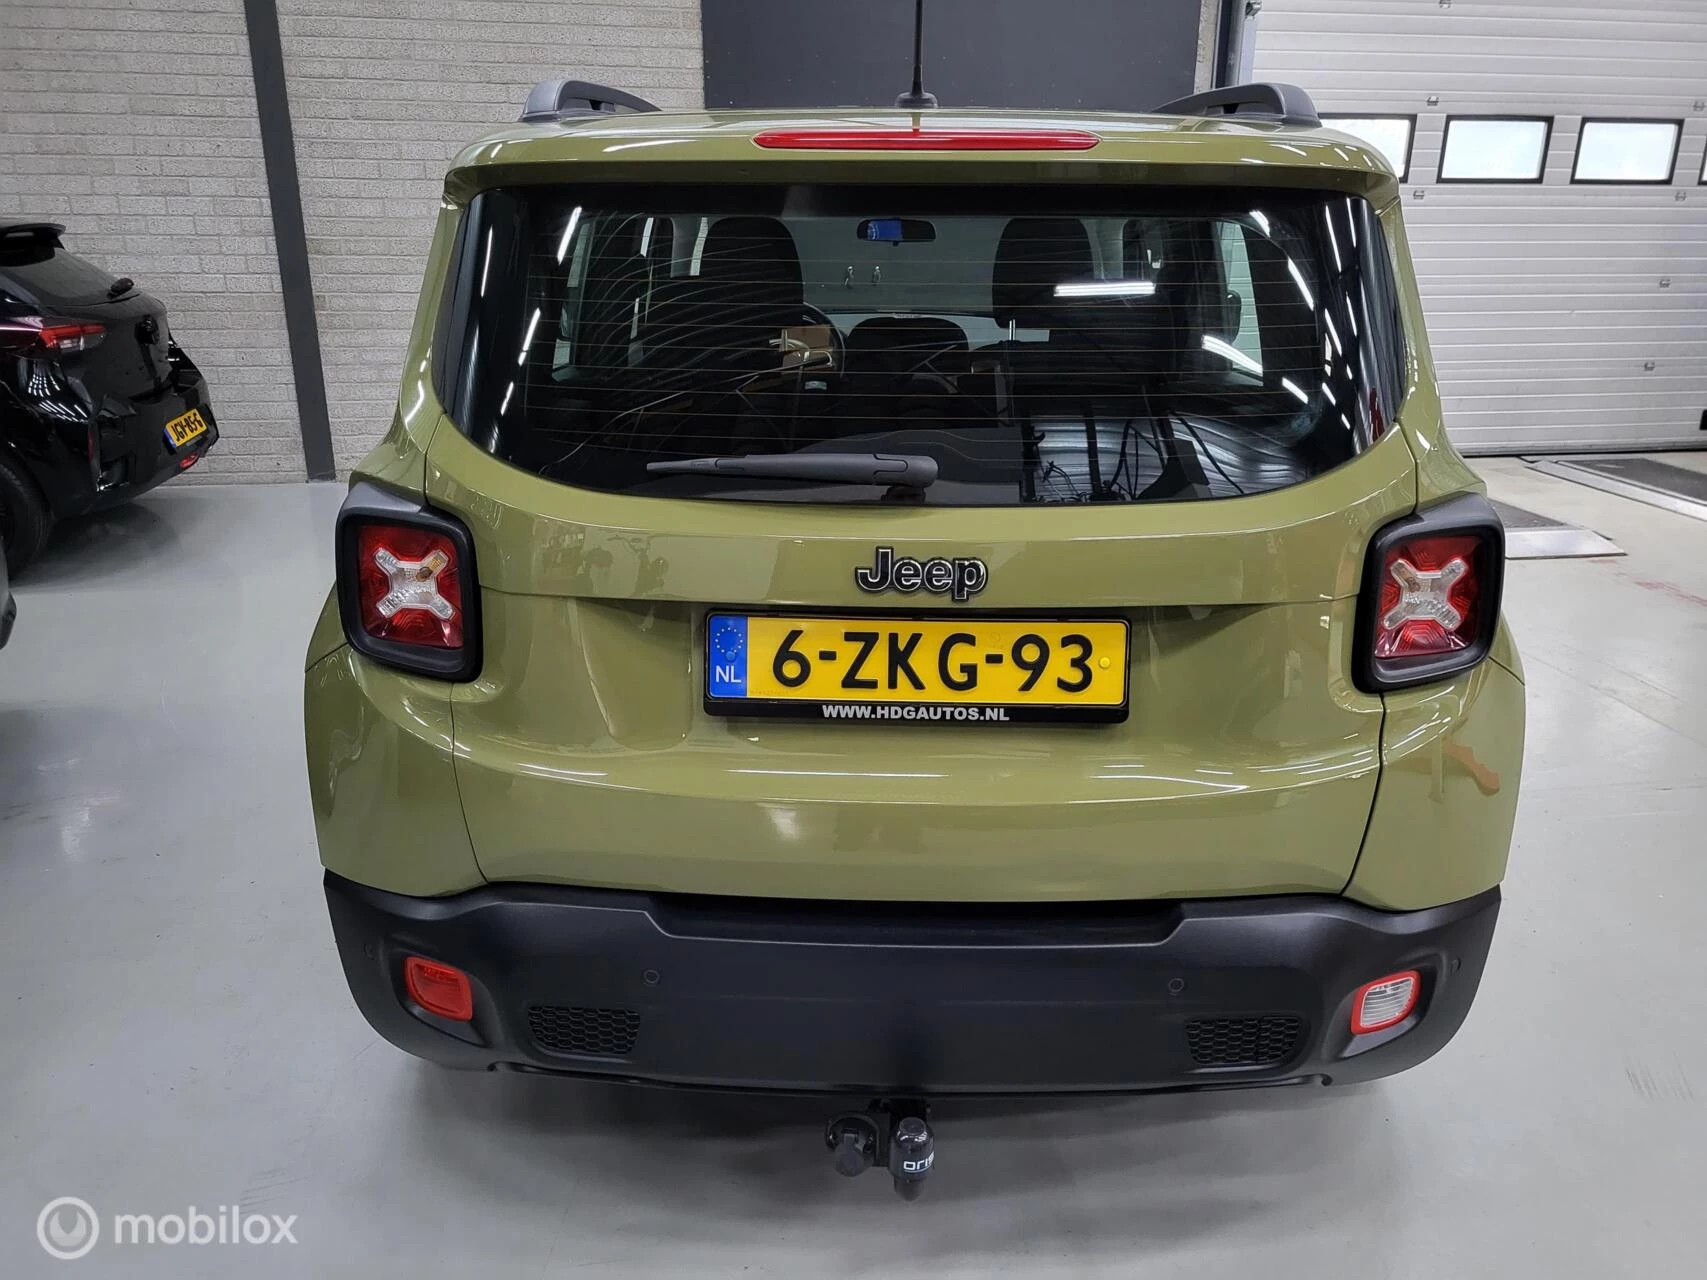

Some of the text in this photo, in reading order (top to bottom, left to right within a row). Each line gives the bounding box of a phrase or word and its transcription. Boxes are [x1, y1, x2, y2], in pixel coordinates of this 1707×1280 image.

[855, 546, 988, 601] Jeep
[715, 665, 742, 684] NL
[772, 629, 1094, 693] 6-ZKG-93
[822, 704, 1010, 721] WWW.HDGAUTOS.NL
